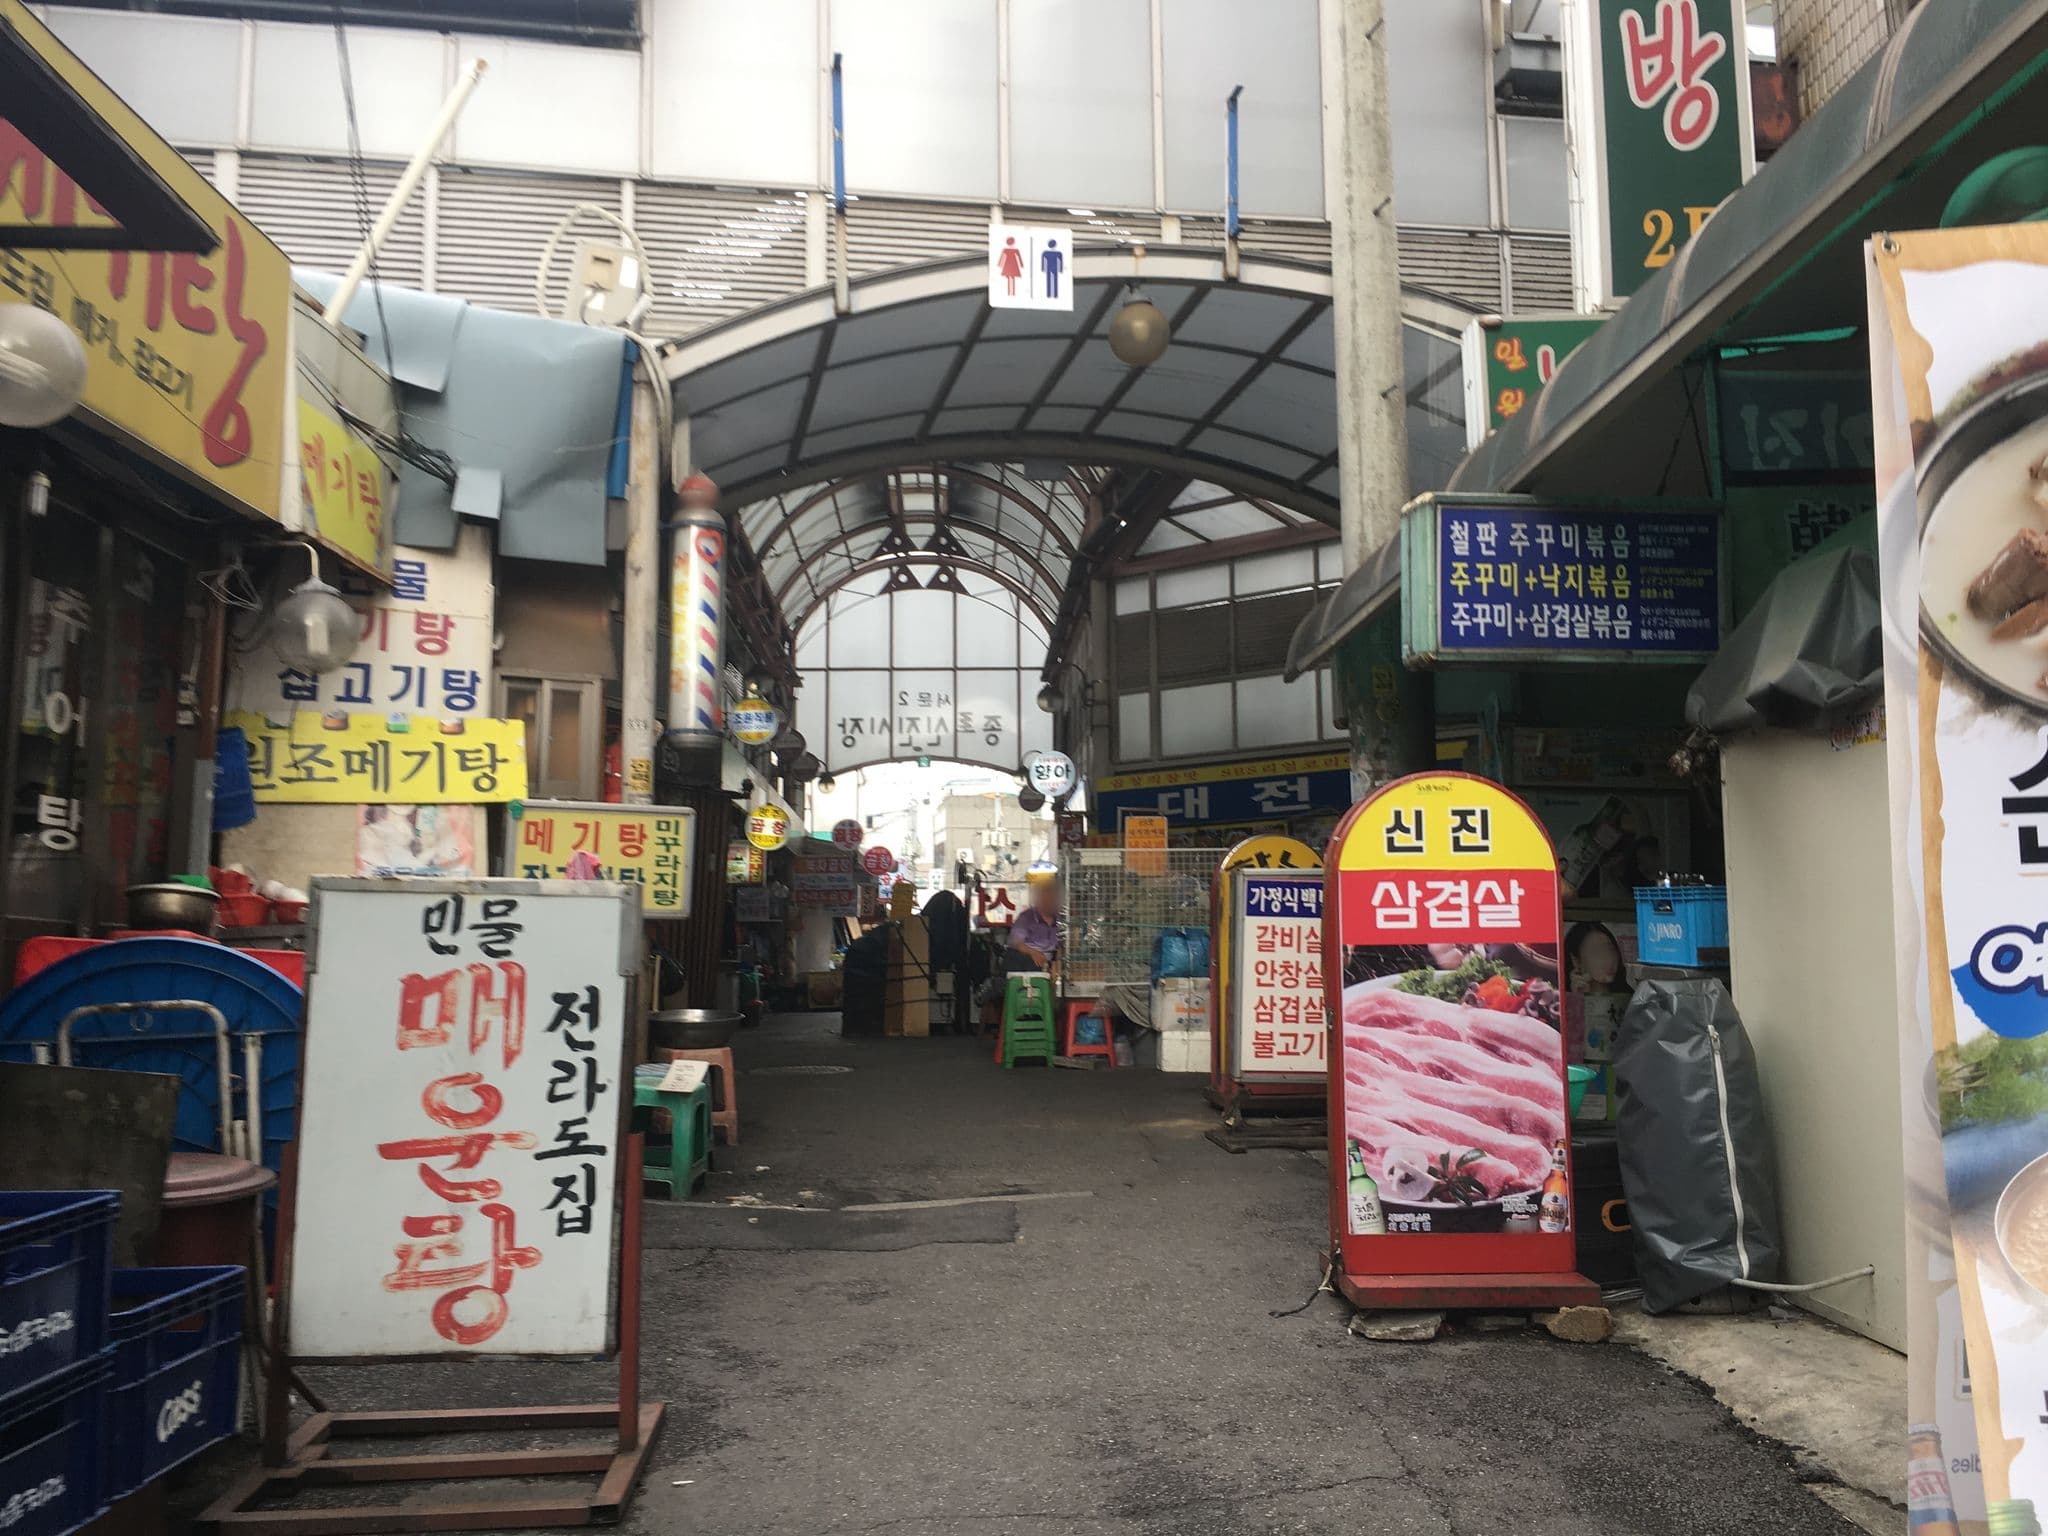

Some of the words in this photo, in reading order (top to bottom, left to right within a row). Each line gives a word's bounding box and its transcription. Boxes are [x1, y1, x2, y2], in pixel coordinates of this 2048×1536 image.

[1621, 0, 1724, 150] 방
[1450, 520, 1499, 557] 철판
[1509, 522, 1632, 560] 주꾸미볶음
[1450, 562, 1632, 600] 주꾸미+낙지볶음
[360, 606, 457, 657] 기탕
[1451, 602, 1633, 641] 주꾸미+삼겹살볶음
[247, 734, 509, 795] 원조메기탕
[523, 818, 649, 858] 메기탕
[1384, 806, 1492, 855] 신진
[653, 819, 683, 907] 미꾸라지탕
[422, 893, 525, 959] 민물
[1250, 886, 1323, 916] 가정식백
[1370, 878, 1526, 929] 삼겹살
[1253, 994, 1327, 1026] 삼겹살
[1252, 1030, 1326, 1061] 불고기
[534, 985, 608, 1237] 전라도집
[376, 960, 543, 1346] 매운탕
